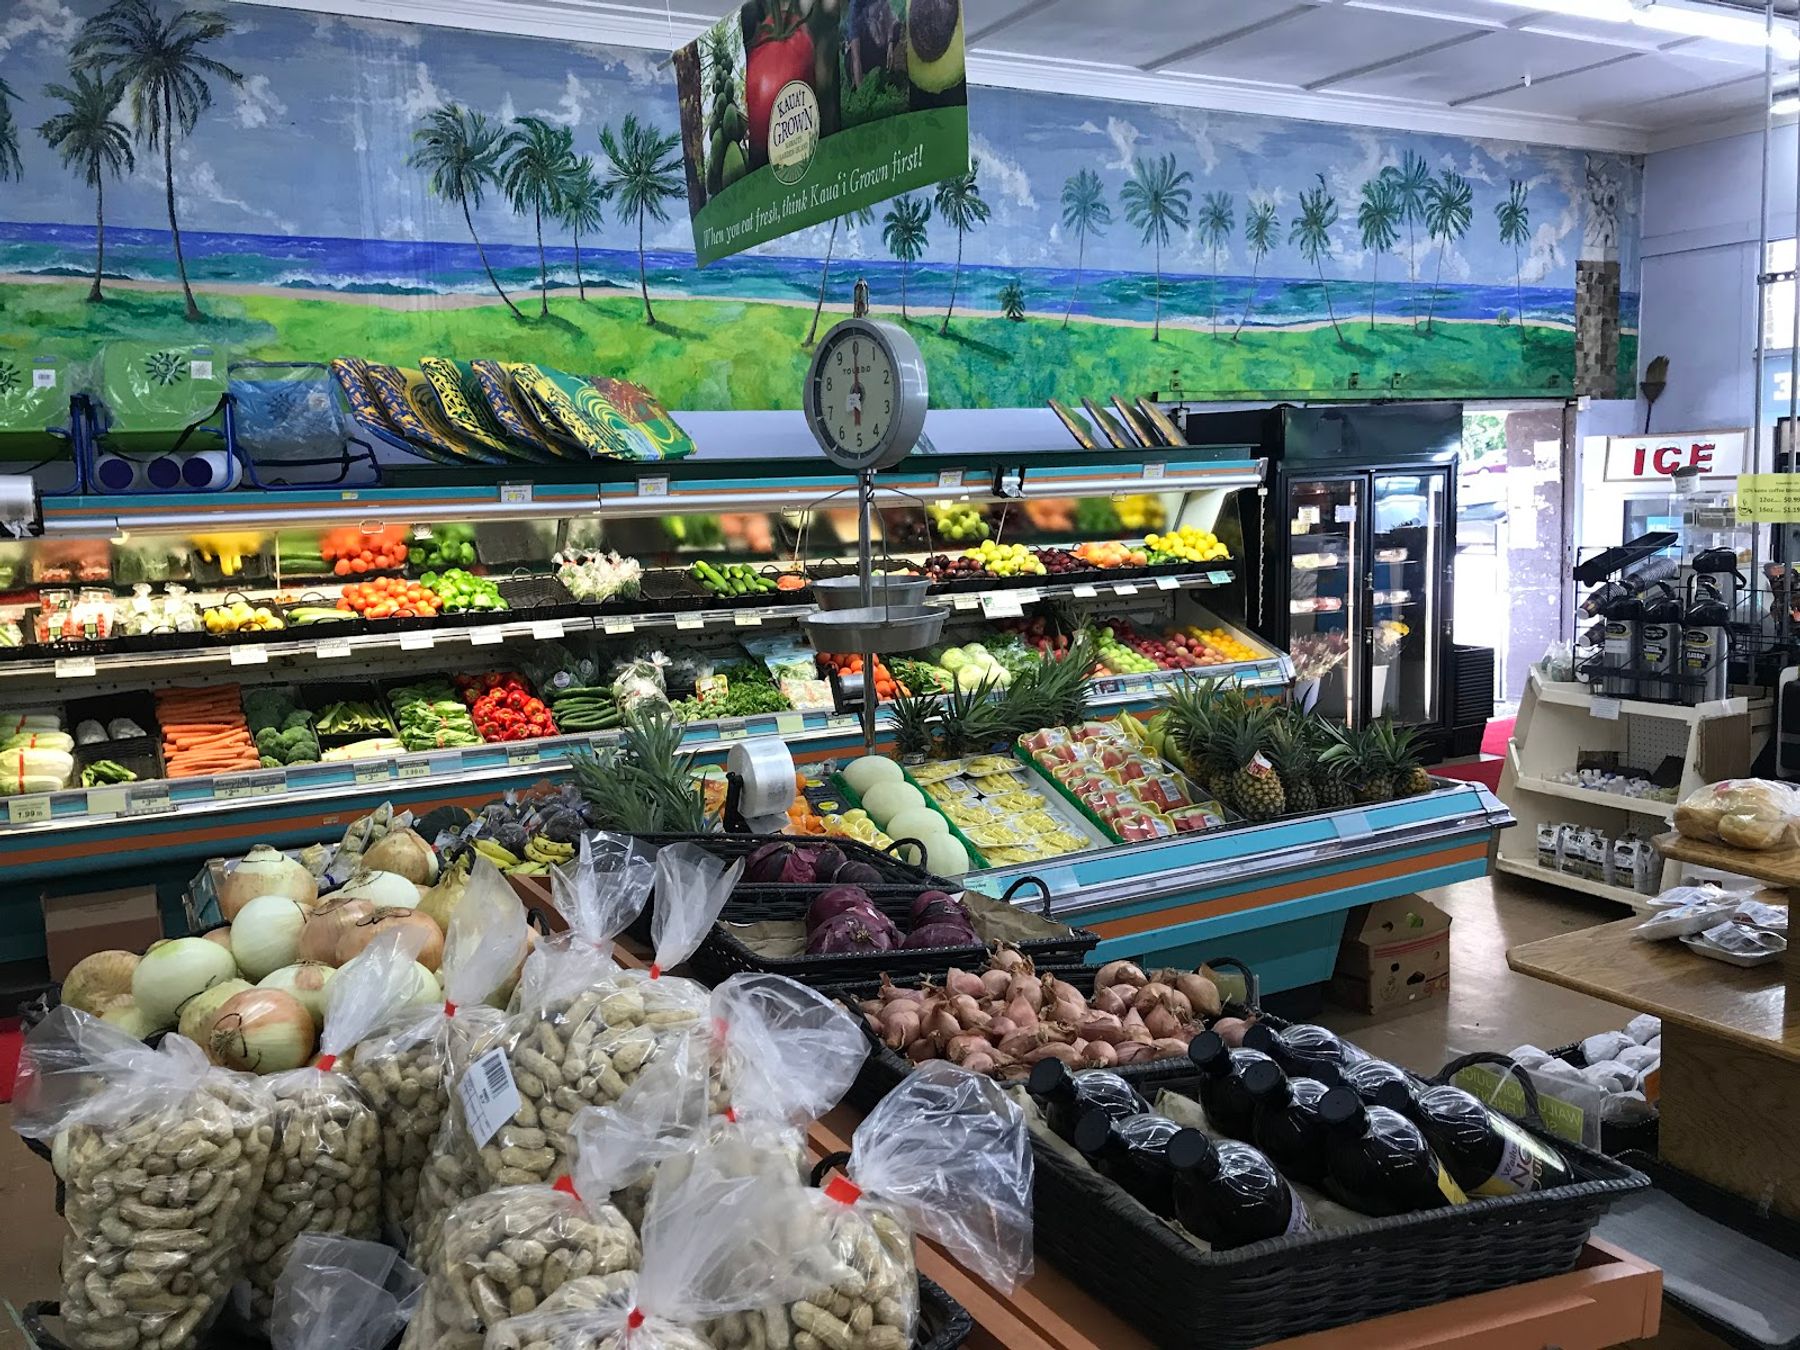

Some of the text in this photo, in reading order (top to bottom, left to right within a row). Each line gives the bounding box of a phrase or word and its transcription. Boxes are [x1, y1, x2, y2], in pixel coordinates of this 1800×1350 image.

[773, 105, 813, 147] GROWN
[703, 224, 724, 248] When
[726, 223, 740, 244] you
[741, 213, 753, 233] eat
[756, 201, 780, 232] fresh,
[782, 189, 808, 218] think
[850, 164, 888, 193] Grown
[892, 144, 923, 182] first!
[837, 352, 843, 365] 9
[872, 347, 876, 361] 1
[827, 377, 832, 391] 8
[884, 370, 890, 384] 2
[828, 406, 833, 420] 7
[885, 400, 890, 414] 3
[839, 426, 845, 439] 6
[873, 424, 879, 437] 4
[856, 433, 862, 447] 5
[1634, 443, 1716, 475] ICE
